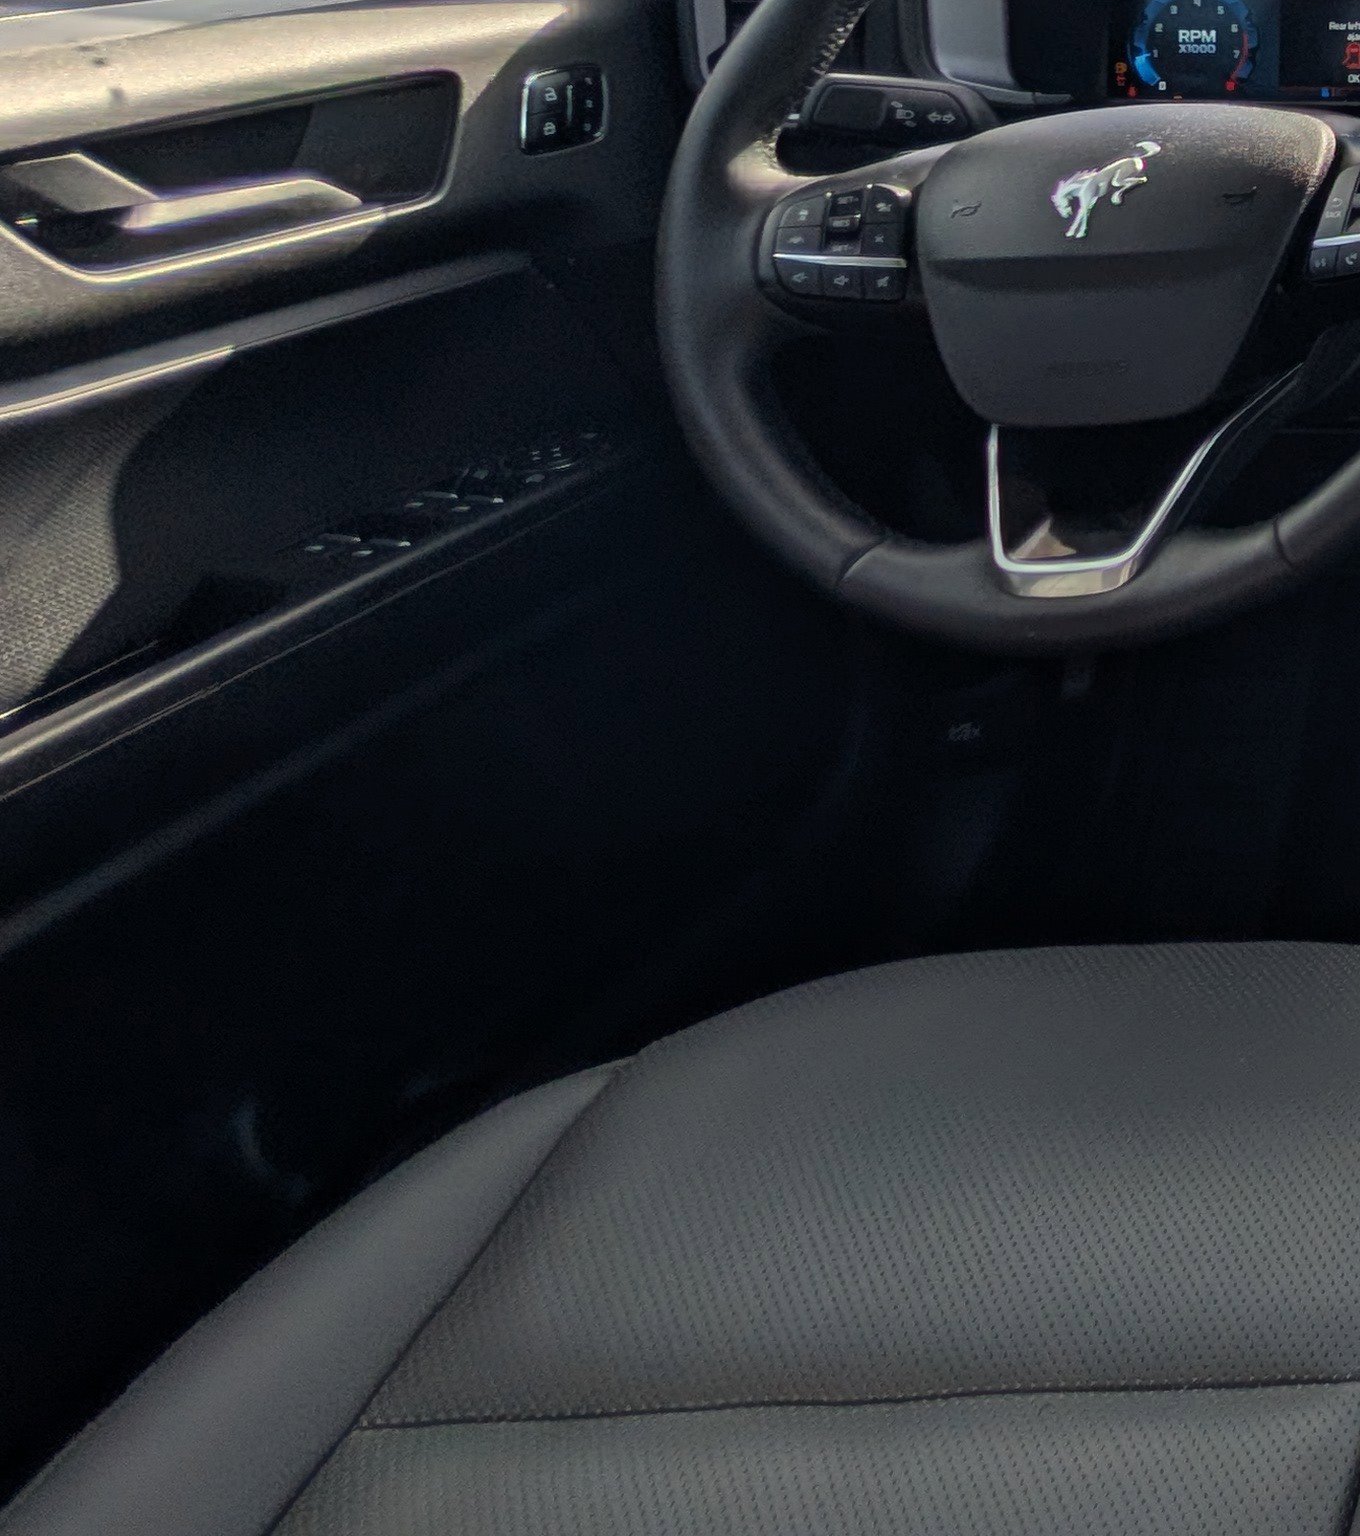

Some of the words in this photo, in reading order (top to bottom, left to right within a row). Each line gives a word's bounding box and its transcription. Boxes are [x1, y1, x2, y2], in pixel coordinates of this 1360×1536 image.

[1170, 5, 1178, 15] 3
[1216, 5, 1225, 15] 5
[1154, 22, 1163, 33] 2
[1230, 23, 1238, 33] 6
[1328, 21, 1347, 31] Rear
[1348, 21, 1360, 31] left
[1178, 29, 1217, 43] RPM
[1178, 44, 1217, 54] X1000
[1232, 50, 1240, 59] 7
[1347, 74, 1360, 84] OK
